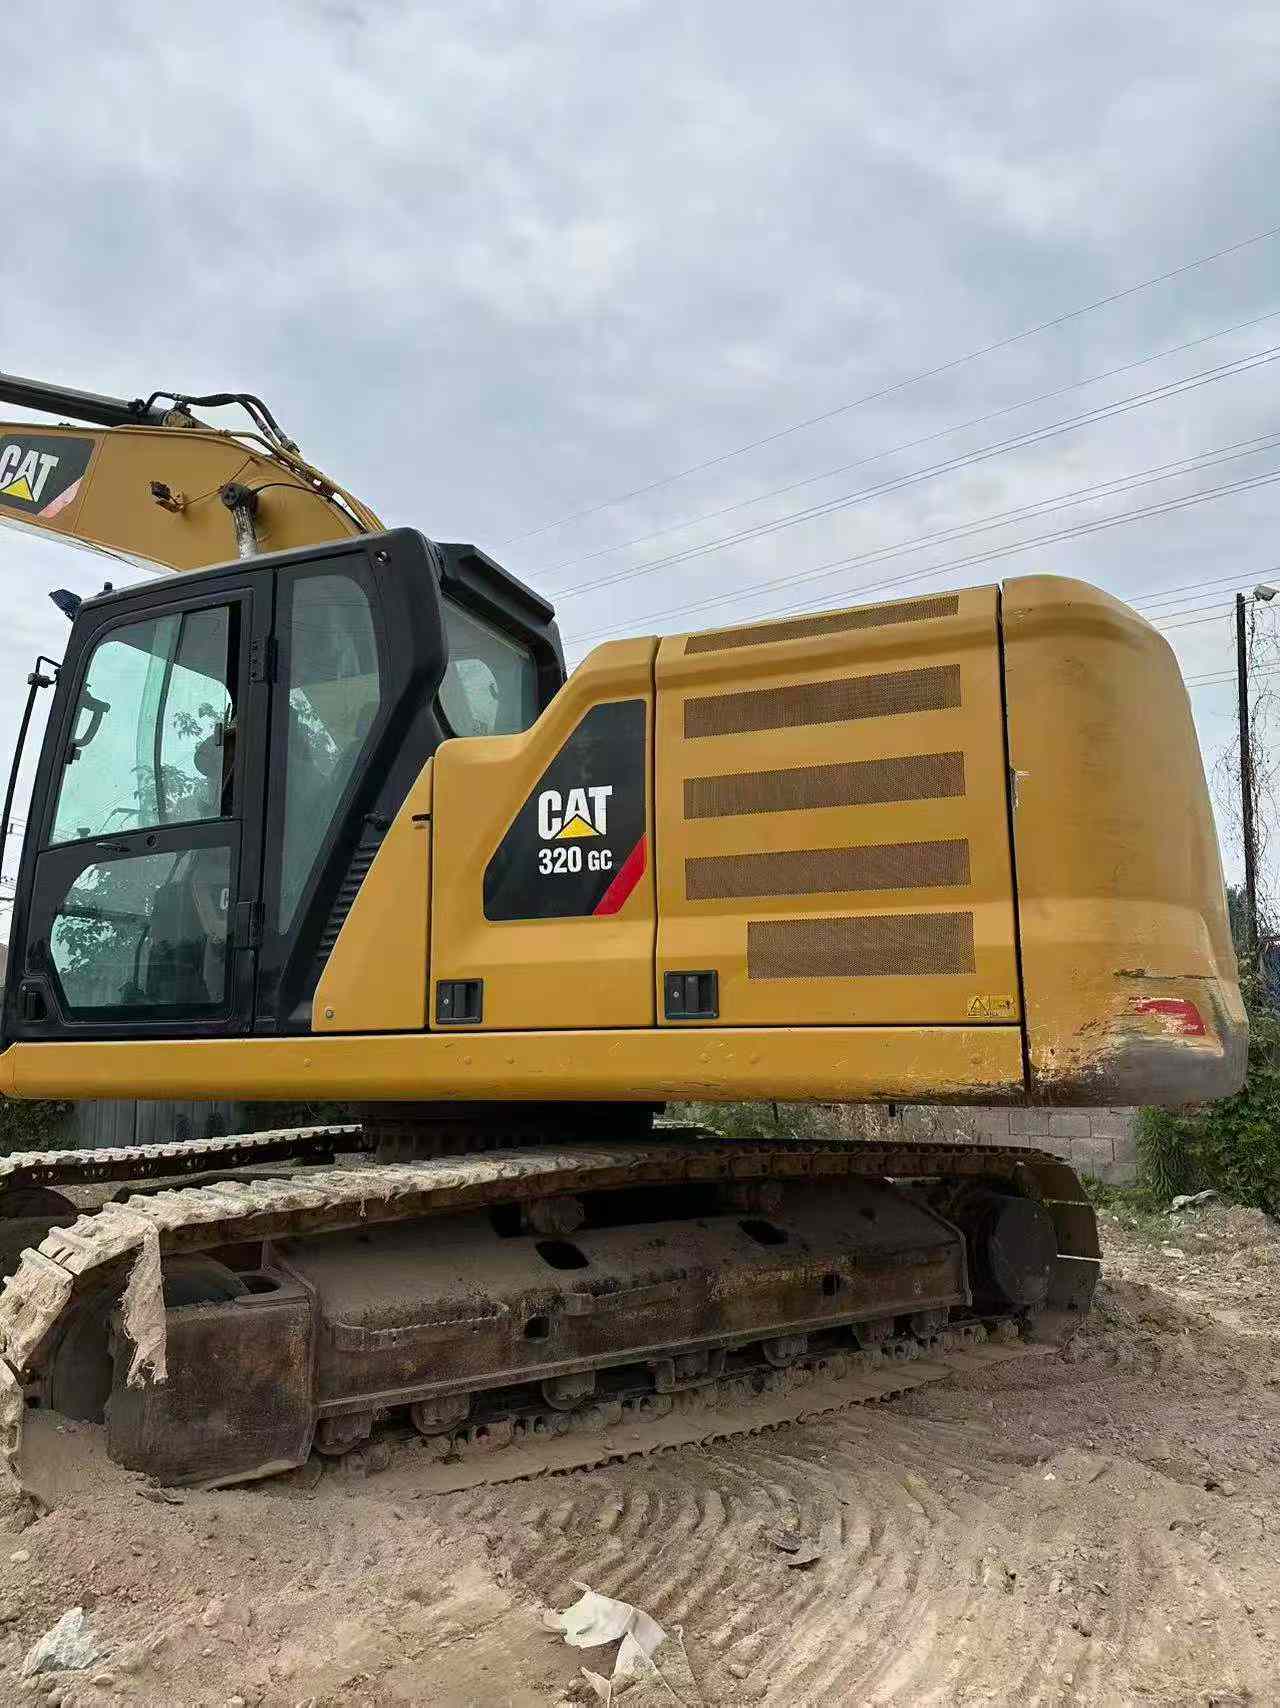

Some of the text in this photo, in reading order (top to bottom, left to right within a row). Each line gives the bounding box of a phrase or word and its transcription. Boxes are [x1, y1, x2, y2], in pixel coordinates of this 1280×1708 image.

[0, 444, 60, 503] CAT
[538, 785, 613, 840] CAT
[538, 846, 613, 875] 320 GC
